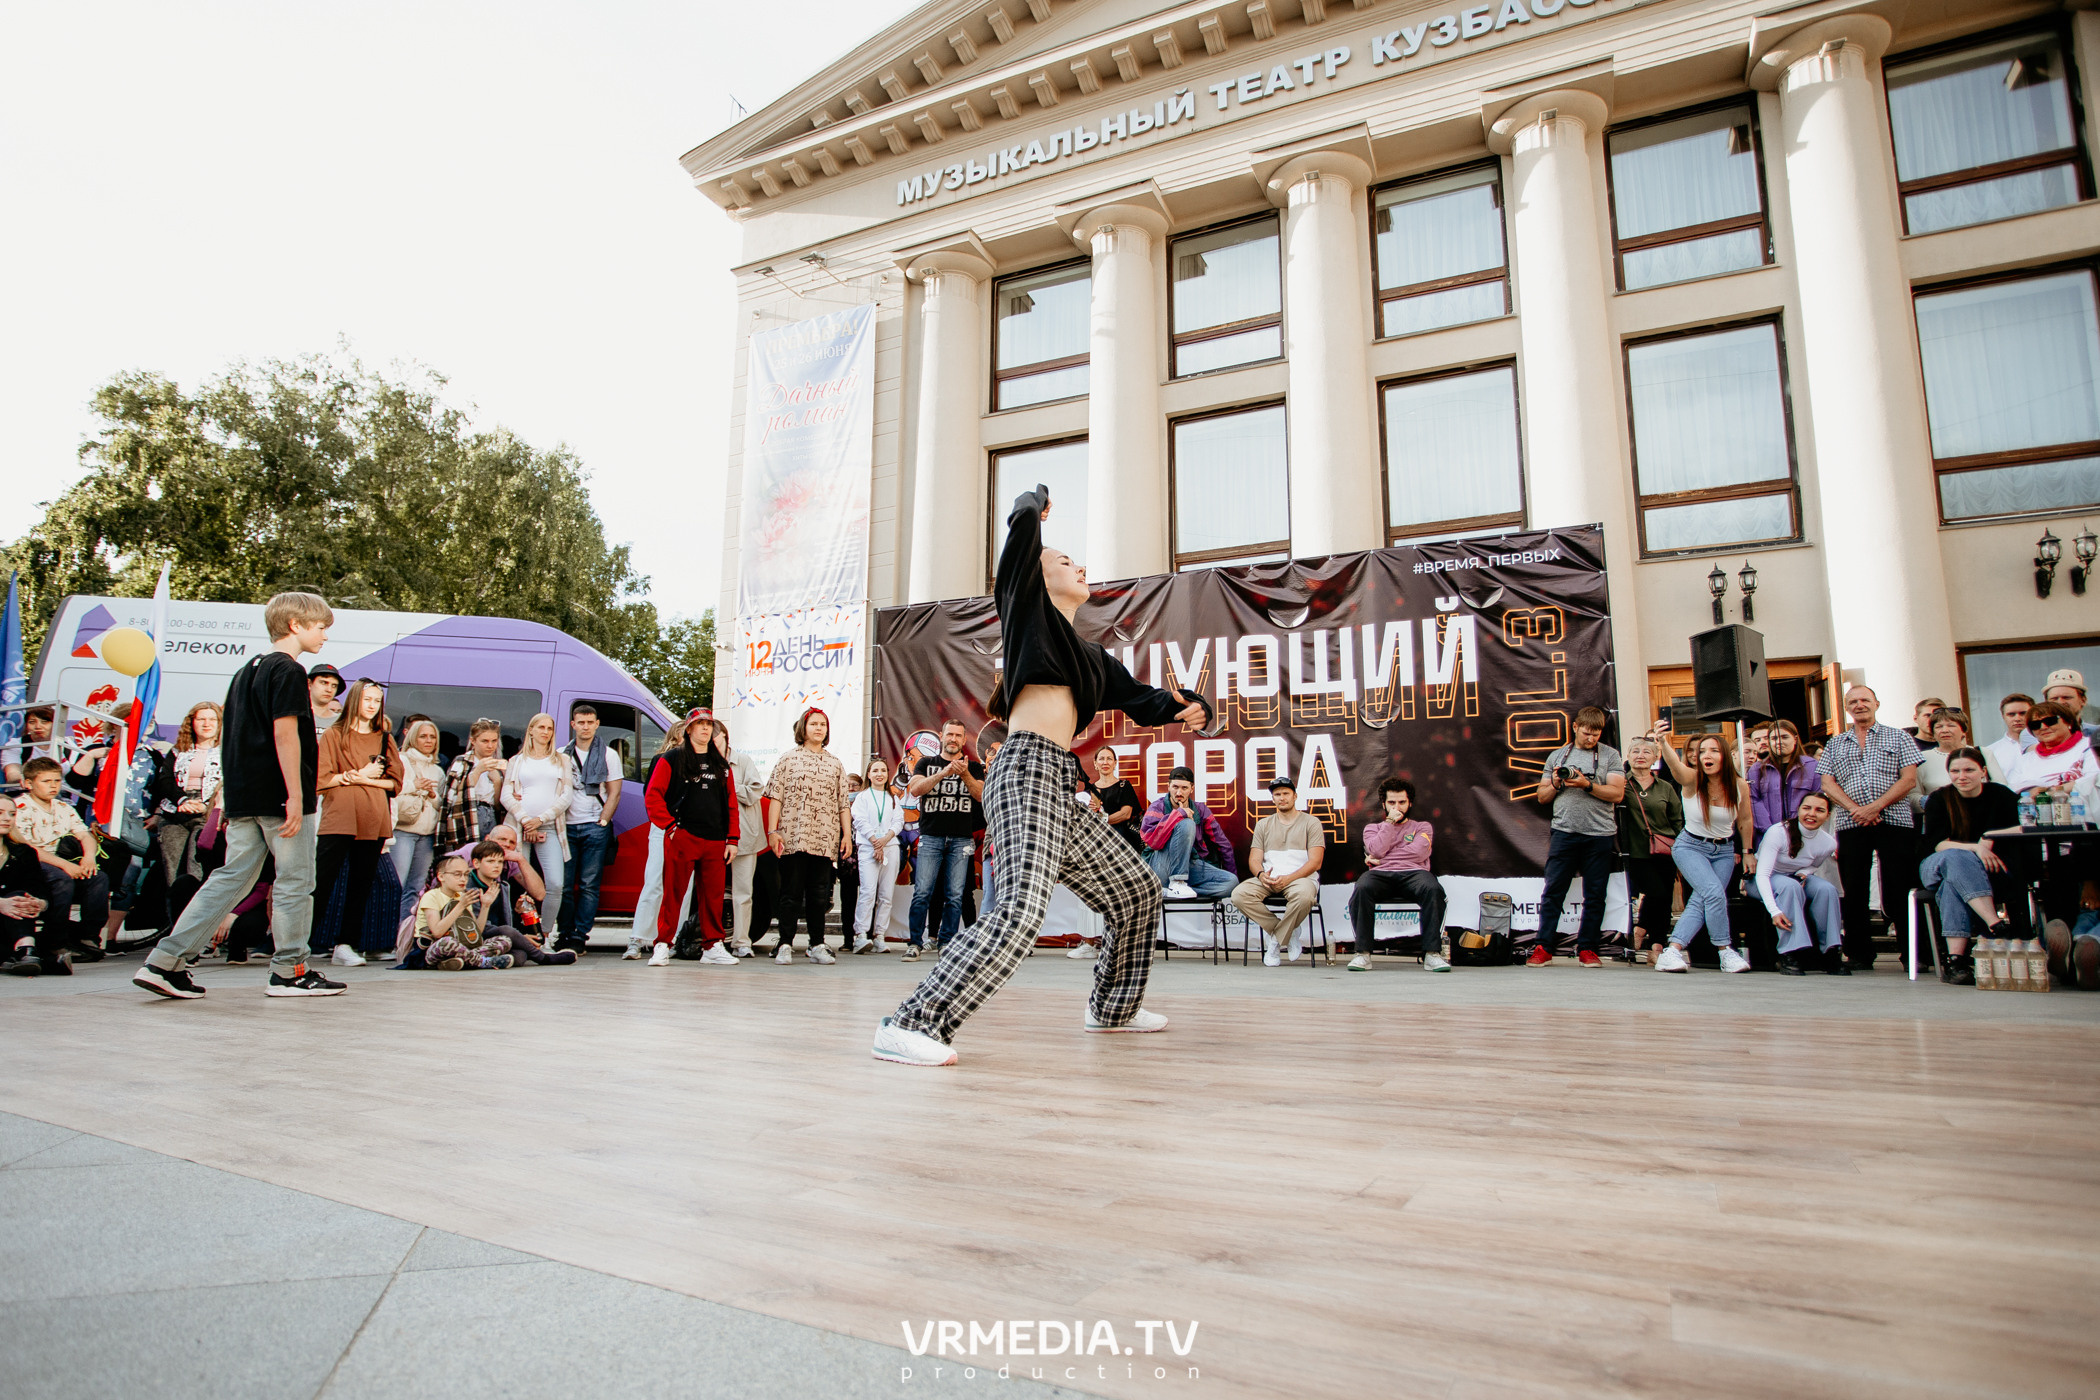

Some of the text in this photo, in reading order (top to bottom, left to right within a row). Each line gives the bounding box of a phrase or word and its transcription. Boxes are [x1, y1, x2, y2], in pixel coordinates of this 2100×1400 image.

[898, 87, 1195, 205] МУЗЫКАЛЬНЫЙ
[1209, 45, 1351, 111] ТЕАТР
[759, 368, 858, 412] Дачный
[761, 401, 848, 445] роман
[1412, 548, 1561, 574] #ВРЕМЯ_ПЕРВЫХ
[223, 621, 251, 630] RT.RU
[164, 640, 246, 655] елеком
[746, 640, 773, 670] 12
[773, 634, 825, 656] ДЕНЬ
[772, 647, 853, 675] РОССИИ
